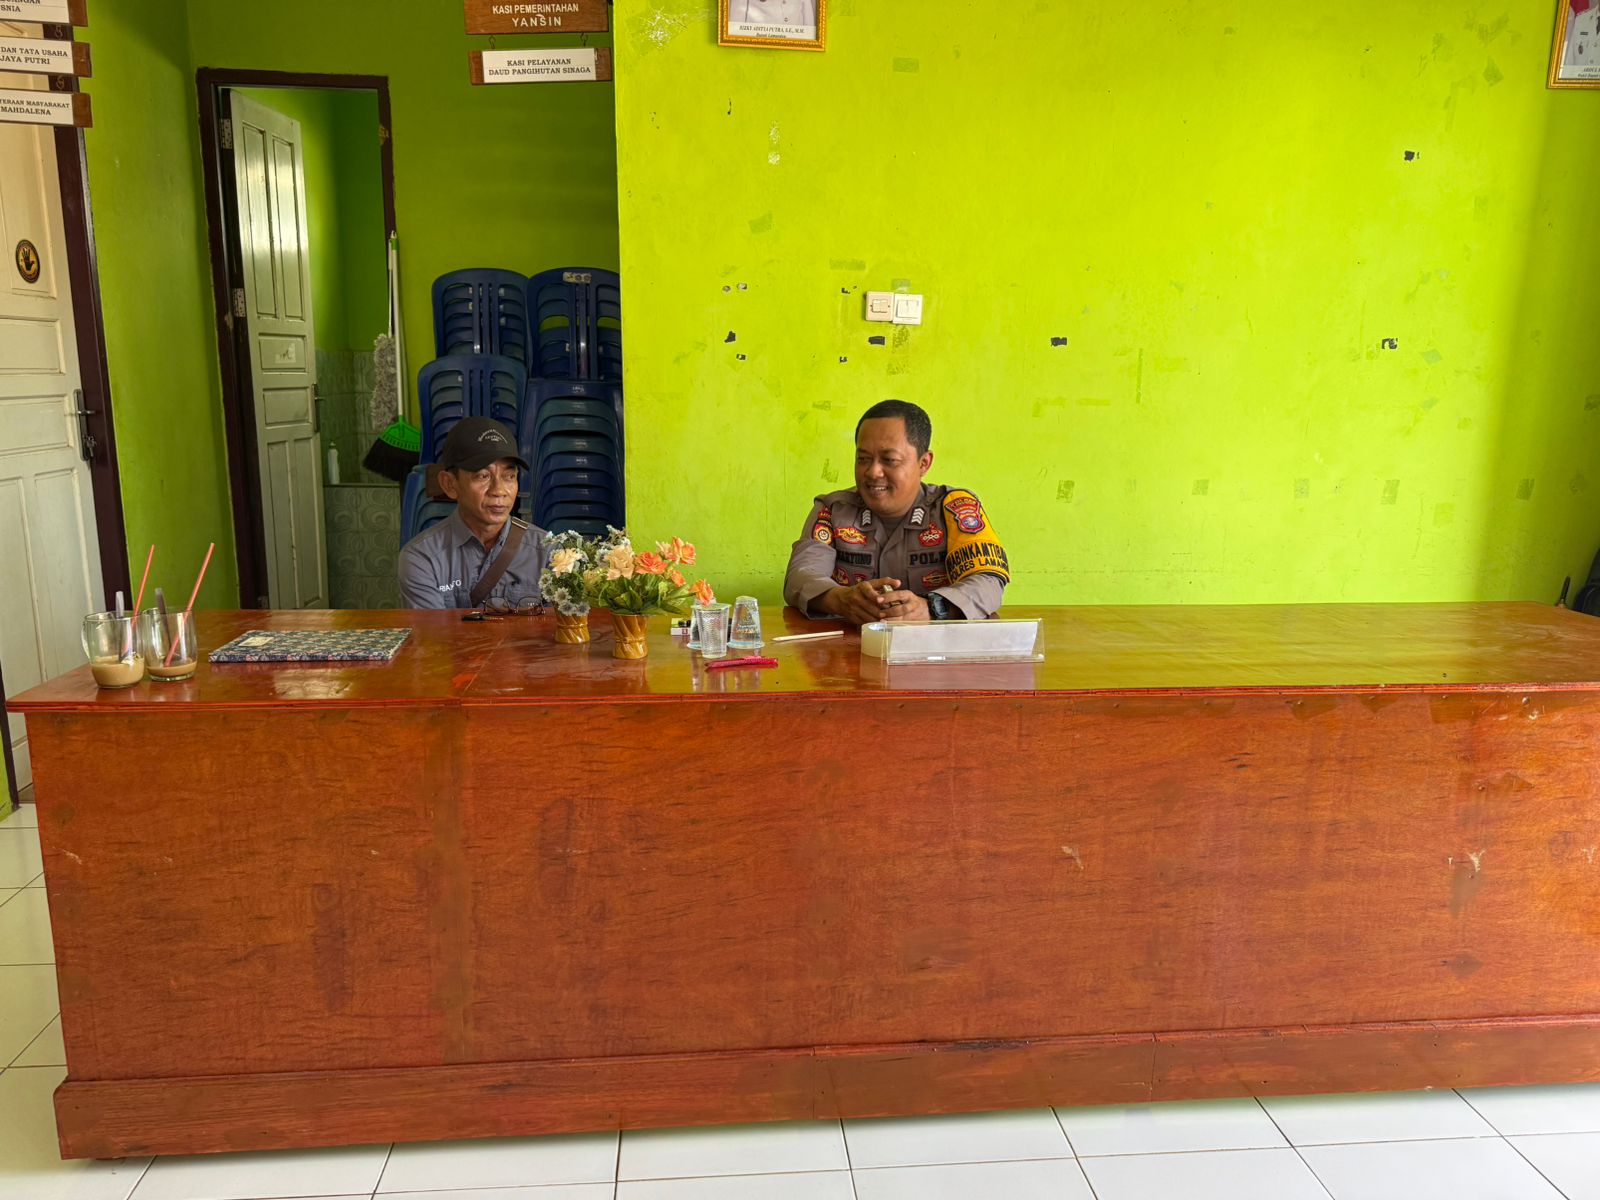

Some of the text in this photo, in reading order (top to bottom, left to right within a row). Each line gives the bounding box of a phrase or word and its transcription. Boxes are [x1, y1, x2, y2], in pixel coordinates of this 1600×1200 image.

[492, 3, 579, 14] KASI PEMERINTAHAN
[512, 16, 562, 27] YANSIN
[0, 46, 17, 54] DAN
[41, 49, 68, 57] USAHA
[25, 57, 51, 65] PUTRI
[507, 58, 572, 67] KASI PELAYANAN
[562, 66, 591, 74] SINAGA
[26, 100, 70, 109] MASYARAKAT
[0, 106, 51, 115] MAHDALENA
